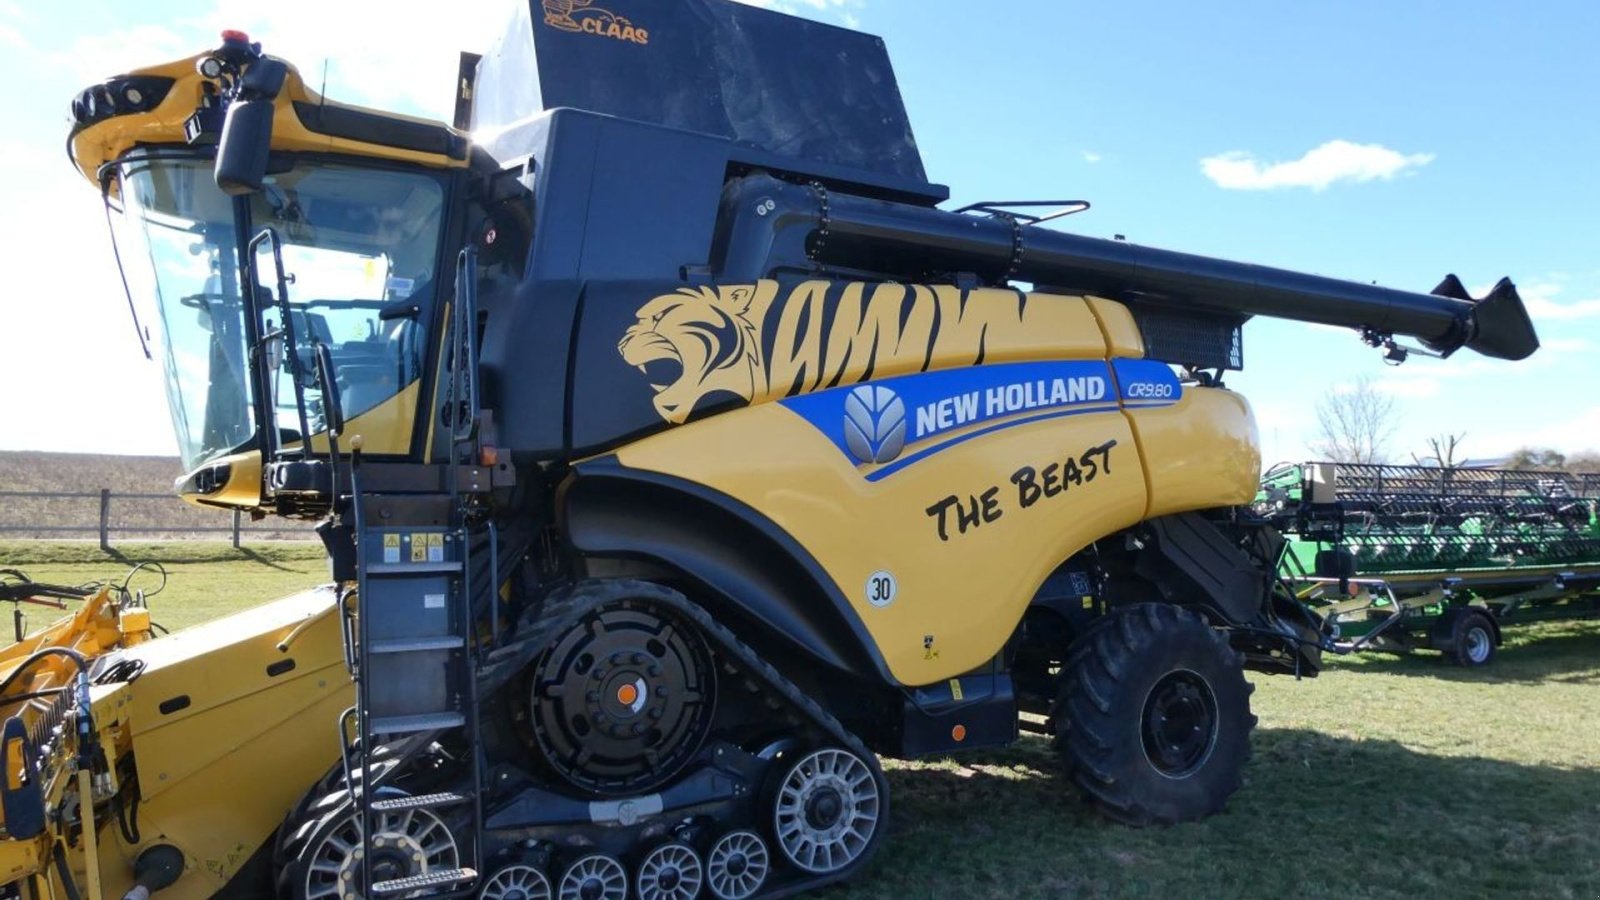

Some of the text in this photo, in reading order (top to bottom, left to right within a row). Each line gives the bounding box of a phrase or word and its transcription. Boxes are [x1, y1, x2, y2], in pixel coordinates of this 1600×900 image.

[582, 17, 648, 44] CLAAS
[1128, 383, 1172, 397] CR9.80
[916, 376, 1105, 437] NEW HOLLAND
[926, 439, 1117, 541] THE BEAST
[872, 578, 890, 601] 30
